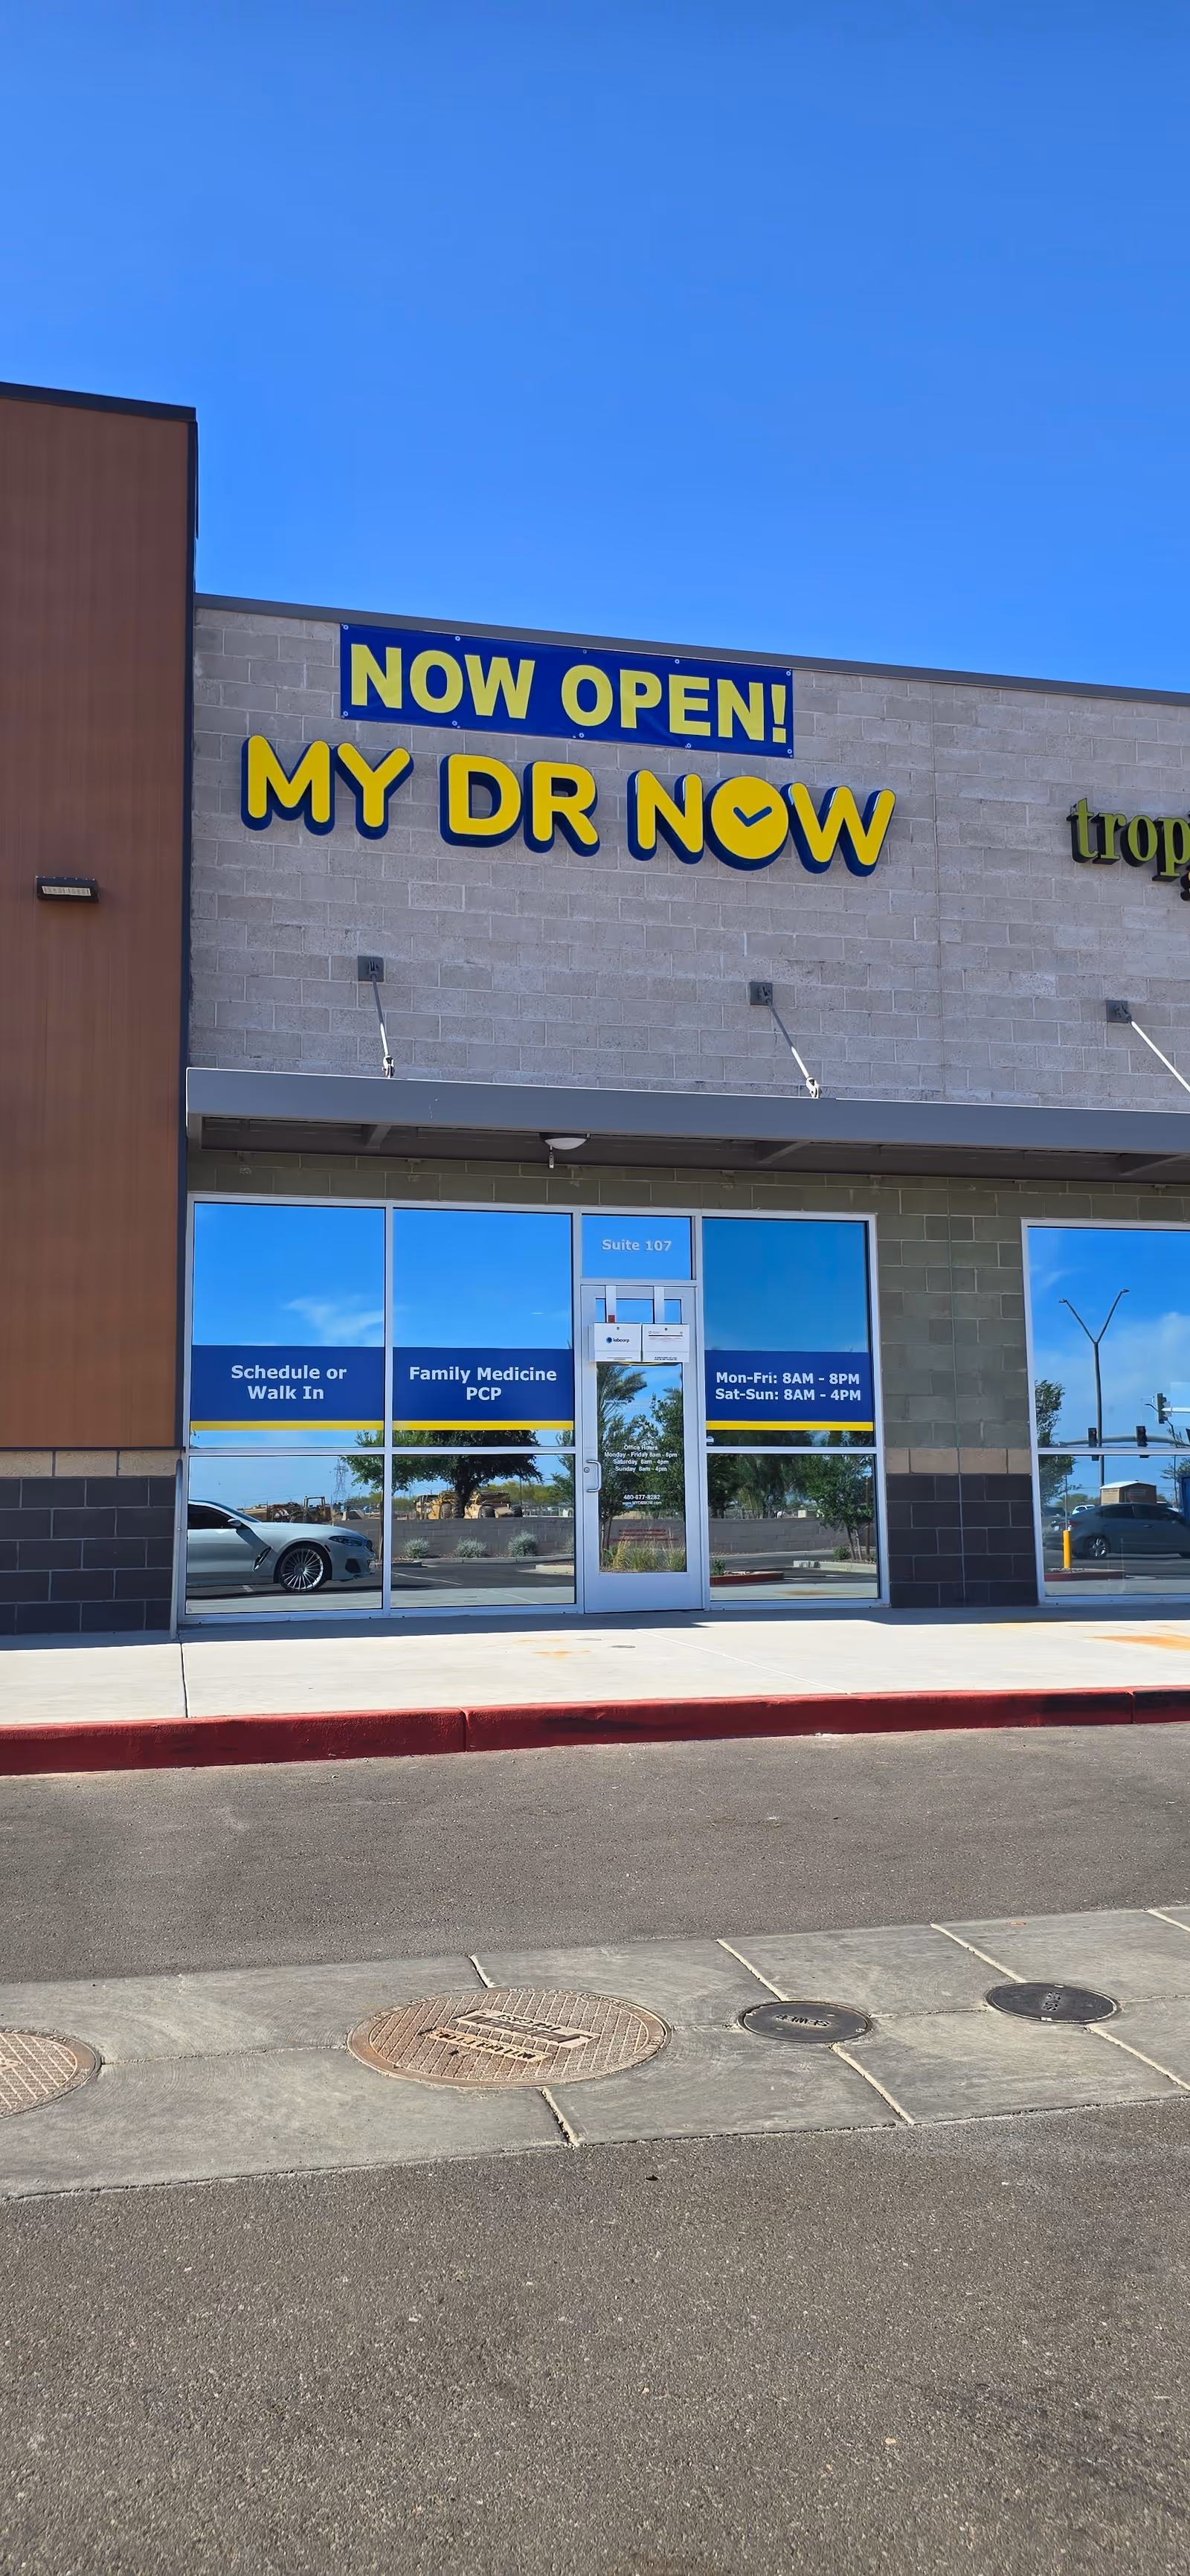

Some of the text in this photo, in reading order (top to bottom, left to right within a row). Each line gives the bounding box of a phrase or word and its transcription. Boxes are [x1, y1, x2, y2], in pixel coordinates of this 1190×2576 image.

[350, 643, 788, 744] NOW OPEN!
[242, 735, 896, 877] MY DR NOW
[602, 1239, 672, 1251] Suite 107
[231, 1365, 347, 1380] Schedule or
[409, 1366, 557, 1384] Family Medicine
[716, 1372, 778, 1384] Mon-Fri:
[782, 1372, 814, 1384] 8AM
[829, 1373, 860, 1385] 8PM
[247, 1386, 324, 1400] Walk In
[466, 1387, 502, 1401] PCP
[715, 1389, 779, 1400] Sat-Sun:
[783, 1389, 815, 1401] 8AM
[830, 1389, 861, 1401] 4PM
[774, 2014, 831, 2028] SEWER
